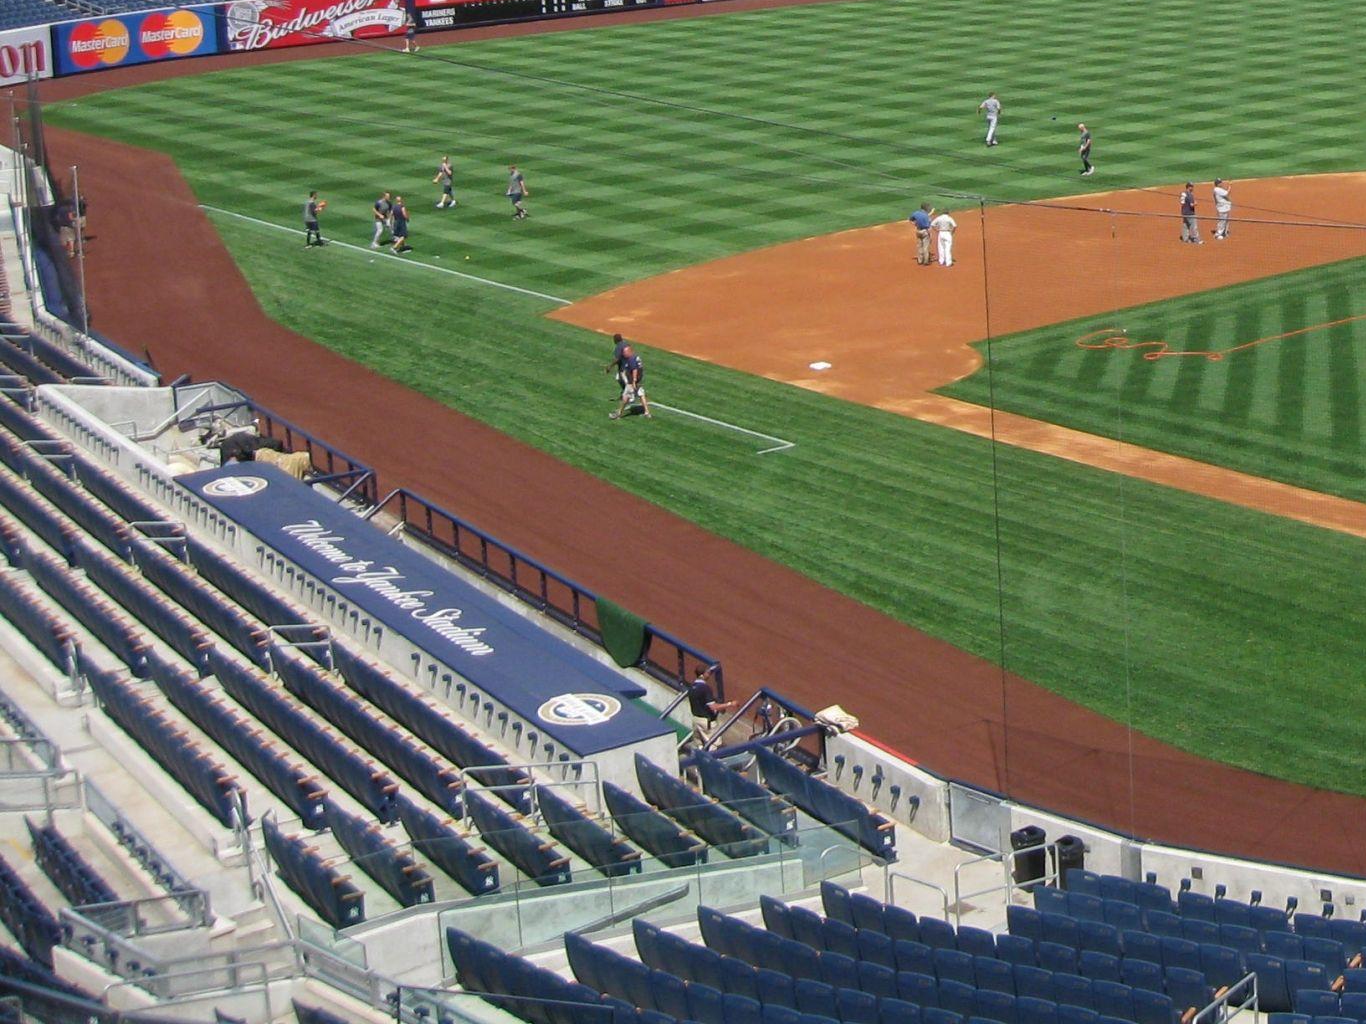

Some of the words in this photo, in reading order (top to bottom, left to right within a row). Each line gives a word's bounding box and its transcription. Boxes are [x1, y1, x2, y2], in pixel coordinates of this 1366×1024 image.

[425, 18, 454, 26] YANKEES
[71, 34, 128, 53] MasterCard
[142, 26, 202, 44] MasterCard
[281, 520, 354, 563] Welcome
[338, 559, 375, 572] to
[331, 566, 435, 610] Yankee
[410, 608, 495, 656] Stadium
